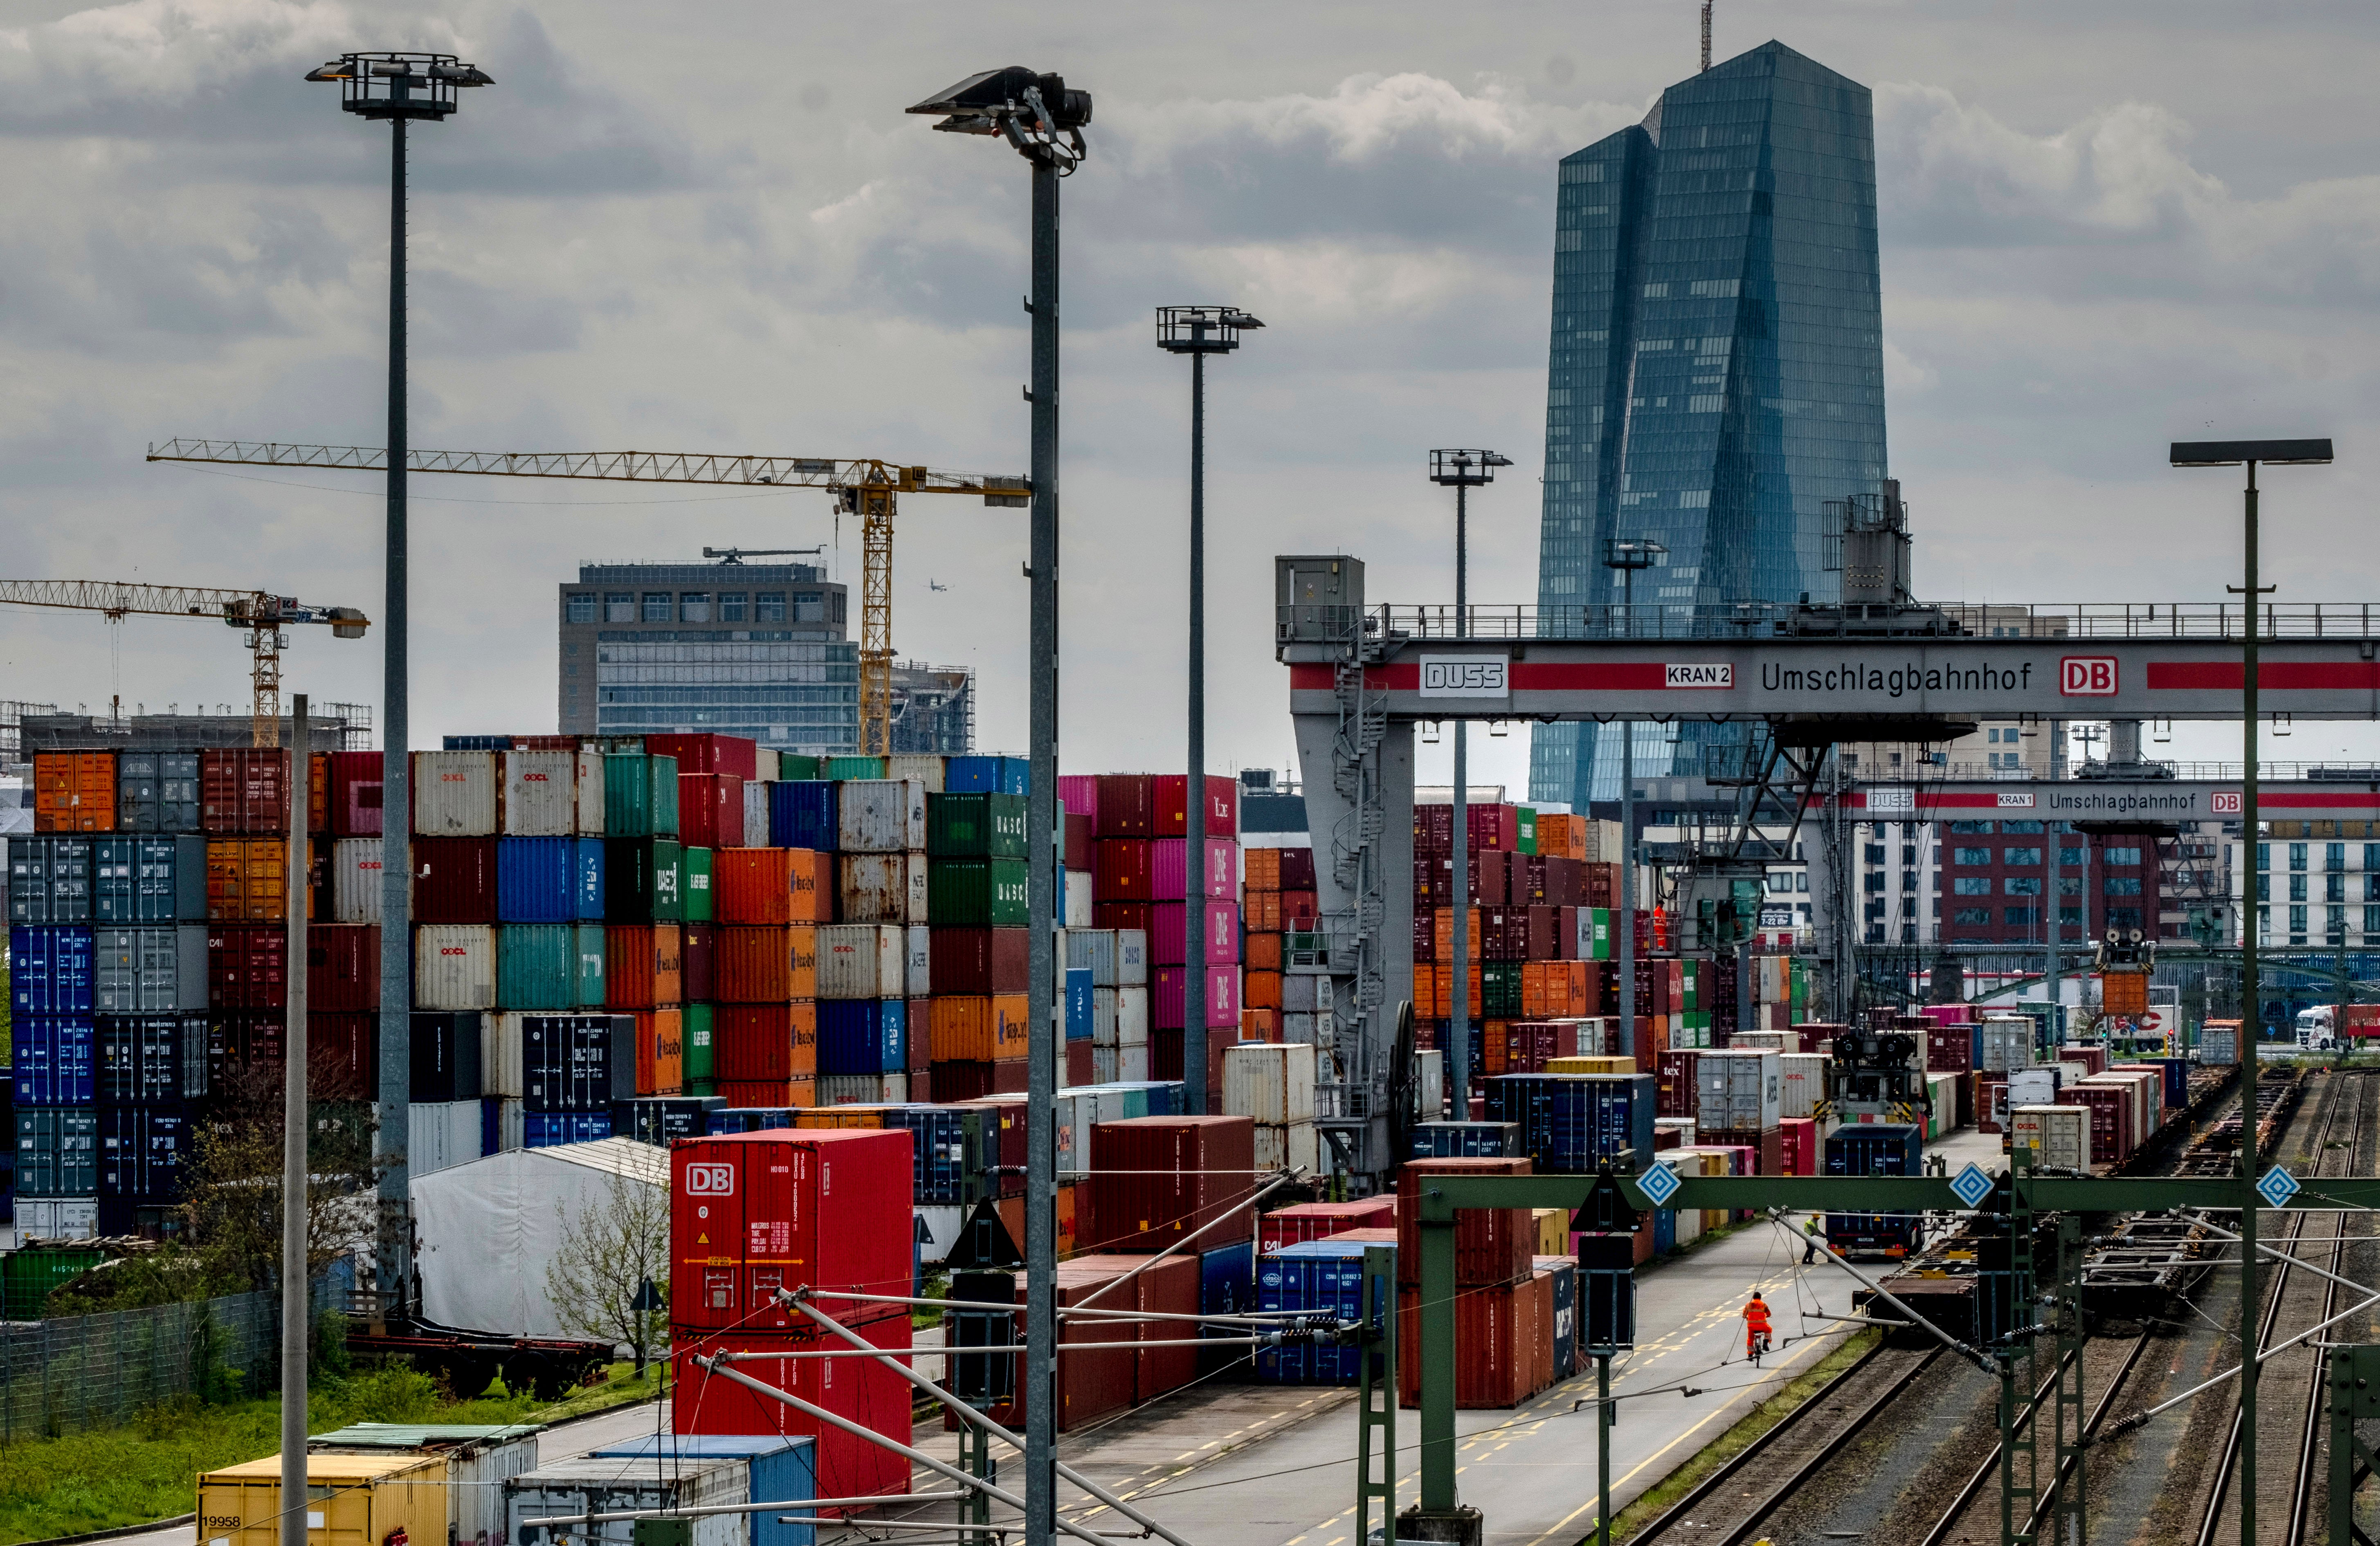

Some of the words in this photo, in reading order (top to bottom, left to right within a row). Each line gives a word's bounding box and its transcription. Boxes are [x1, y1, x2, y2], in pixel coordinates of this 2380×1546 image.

[1425, 662, 1503, 689] DUSS
[1668, 667, 1716, 682] KRAN
[1720, 667, 1729, 682] 2
[1762, 662, 2032, 698] Umschlagbahnhof
[2068, 663, 2110, 689] DB
[441, 773, 466, 781] OOCL
[524, 773, 548, 781] OOCL
[1870, 793, 1913, 807] DUSS
[1999, 796, 2025, 804] KRAN
[2028, 796, 2031, 804] 1
[2050, 793, 2196, 812] Umschlagbahnhof
[2214, 796, 2238, 810] DB
[997, 816, 1020, 834] UASC
[999, 883, 1023, 900] UASC
[209, 939, 223, 947] CAI
[1663, 1066, 1680, 1076] tex
[692, 1168, 729, 1190] DB
[202, 1516, 240, 1527] 19958
